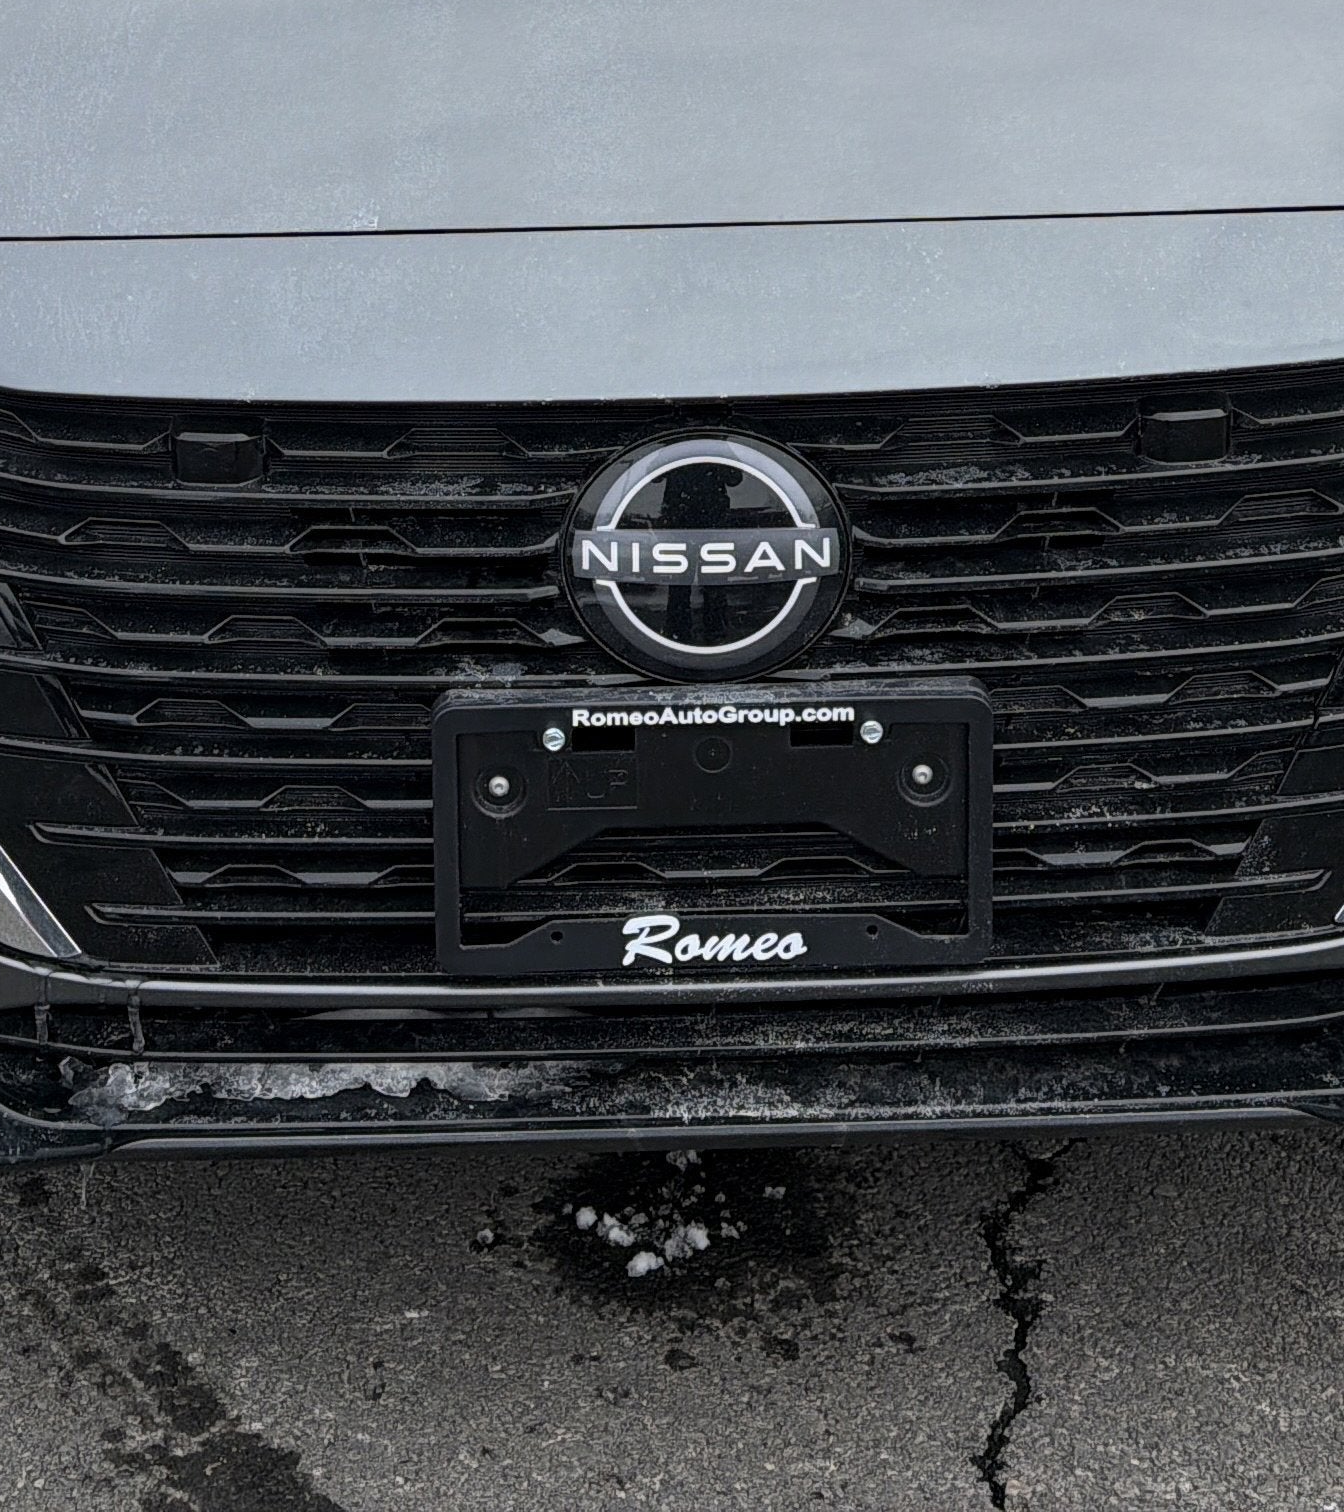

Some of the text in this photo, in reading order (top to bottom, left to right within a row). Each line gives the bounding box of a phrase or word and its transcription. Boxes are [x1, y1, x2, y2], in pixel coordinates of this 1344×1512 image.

[581, 538, 831, 574] NISSAN
[572, 706, 855, 727] RomeoAutoGroup.com
[622, 914, 807, 966] Romeo
